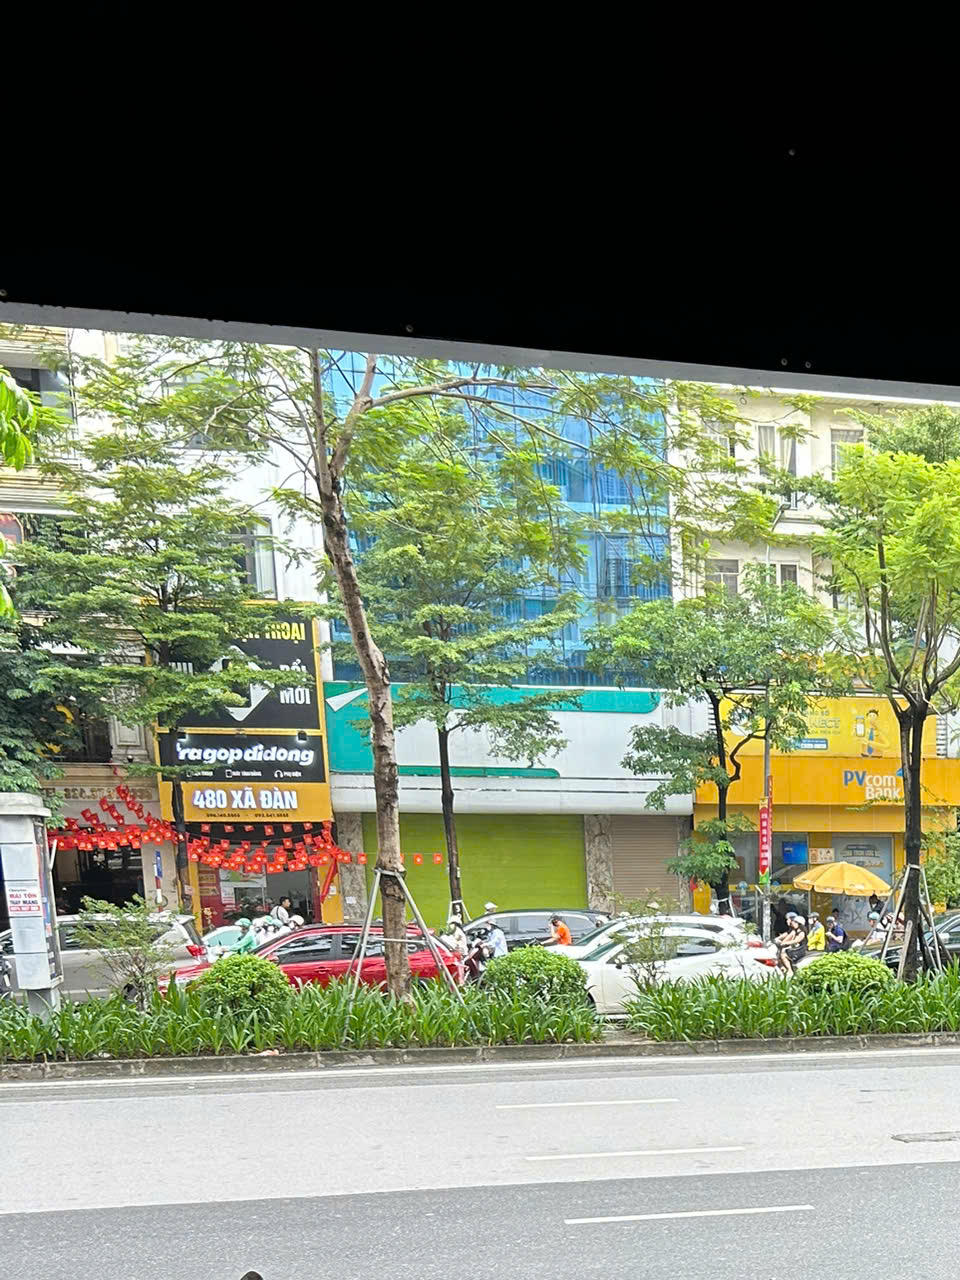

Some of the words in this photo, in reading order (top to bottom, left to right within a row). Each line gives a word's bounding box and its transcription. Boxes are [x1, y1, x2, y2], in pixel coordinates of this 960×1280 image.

[843, 770, 896, 787] PVcom
[193, 789, 228, 809] 480
[231, 786, 257, 809] XÃ
[259, 786, 298, 810] ĐÀN
[866, 787, 900, 800] Bank
